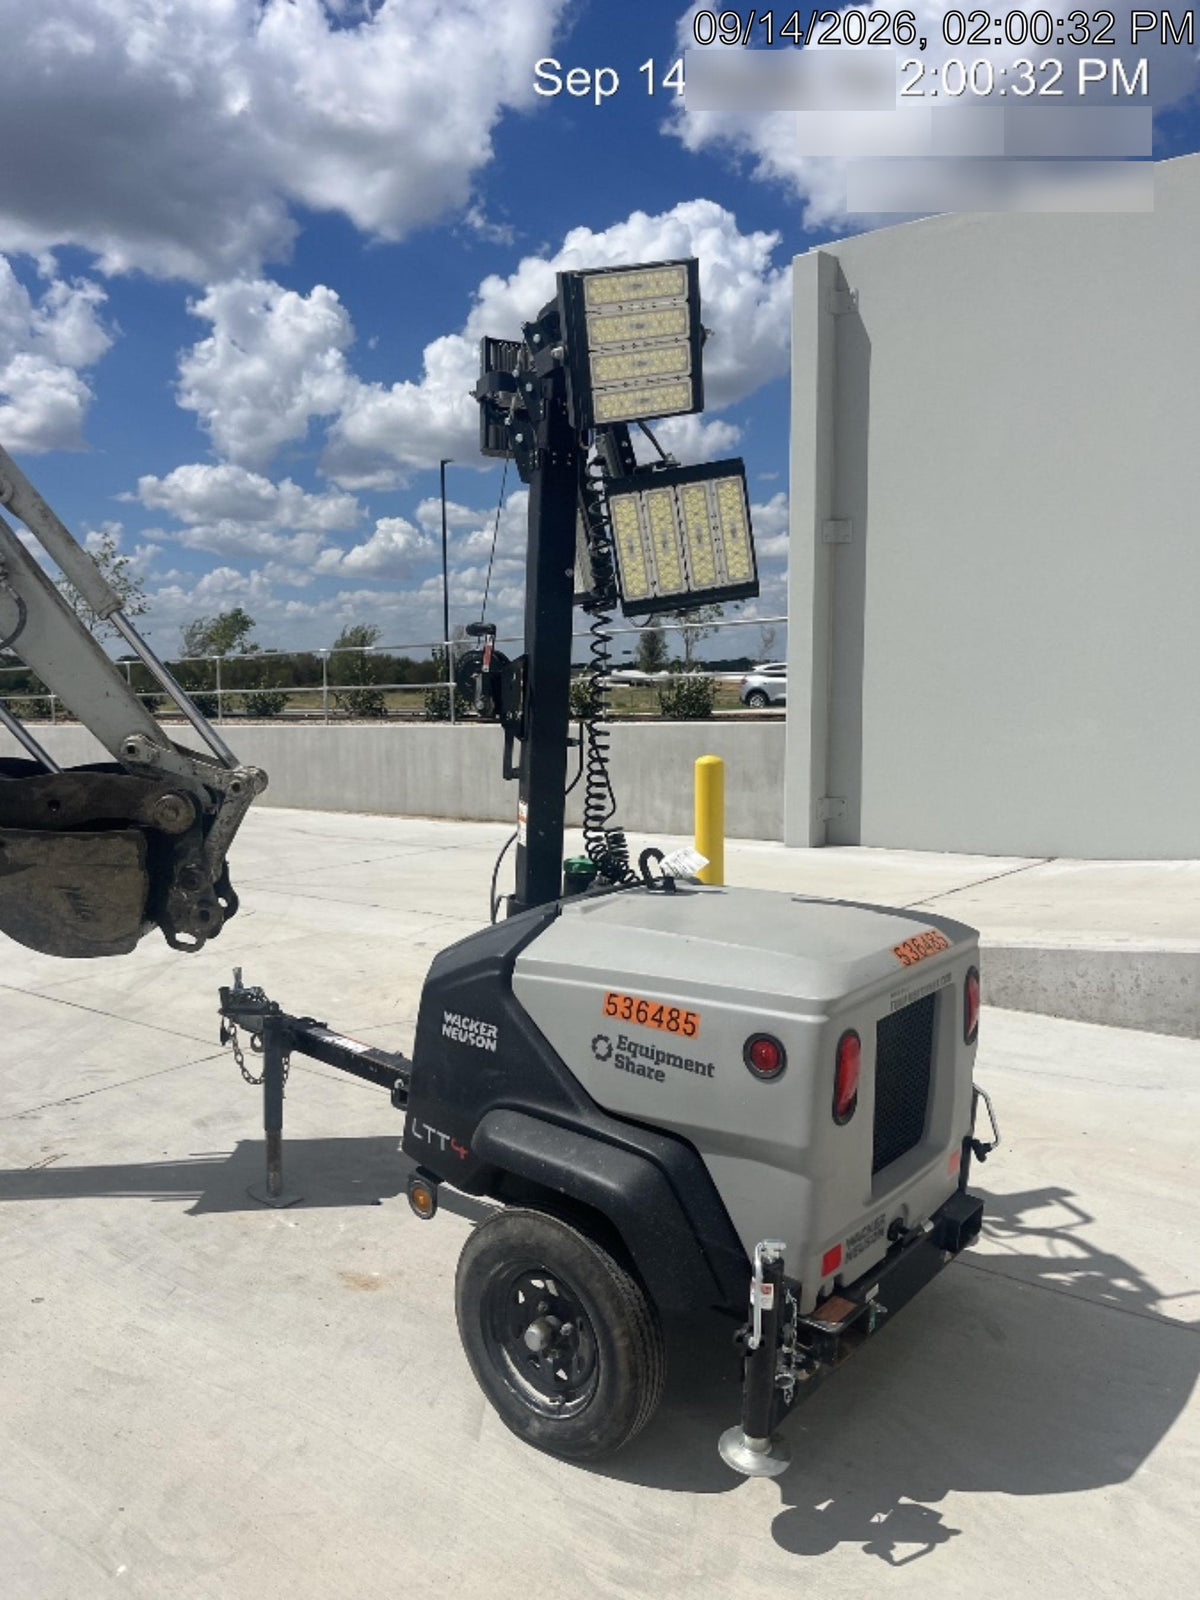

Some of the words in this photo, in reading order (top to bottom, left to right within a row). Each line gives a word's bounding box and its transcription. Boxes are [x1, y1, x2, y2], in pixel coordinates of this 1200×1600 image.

[893, 930, 949, 967] 536485
[443, 1010, 498, 1039] WACKER
[605, 993, 697, 1037] 536485
[442, 1023, 497, 1053] NEUSON
[616, 1034, 716, 1078] Equipment
[614, 1053, 666, 1083] Share
[411, 1117, 469, 1160] LTT4
